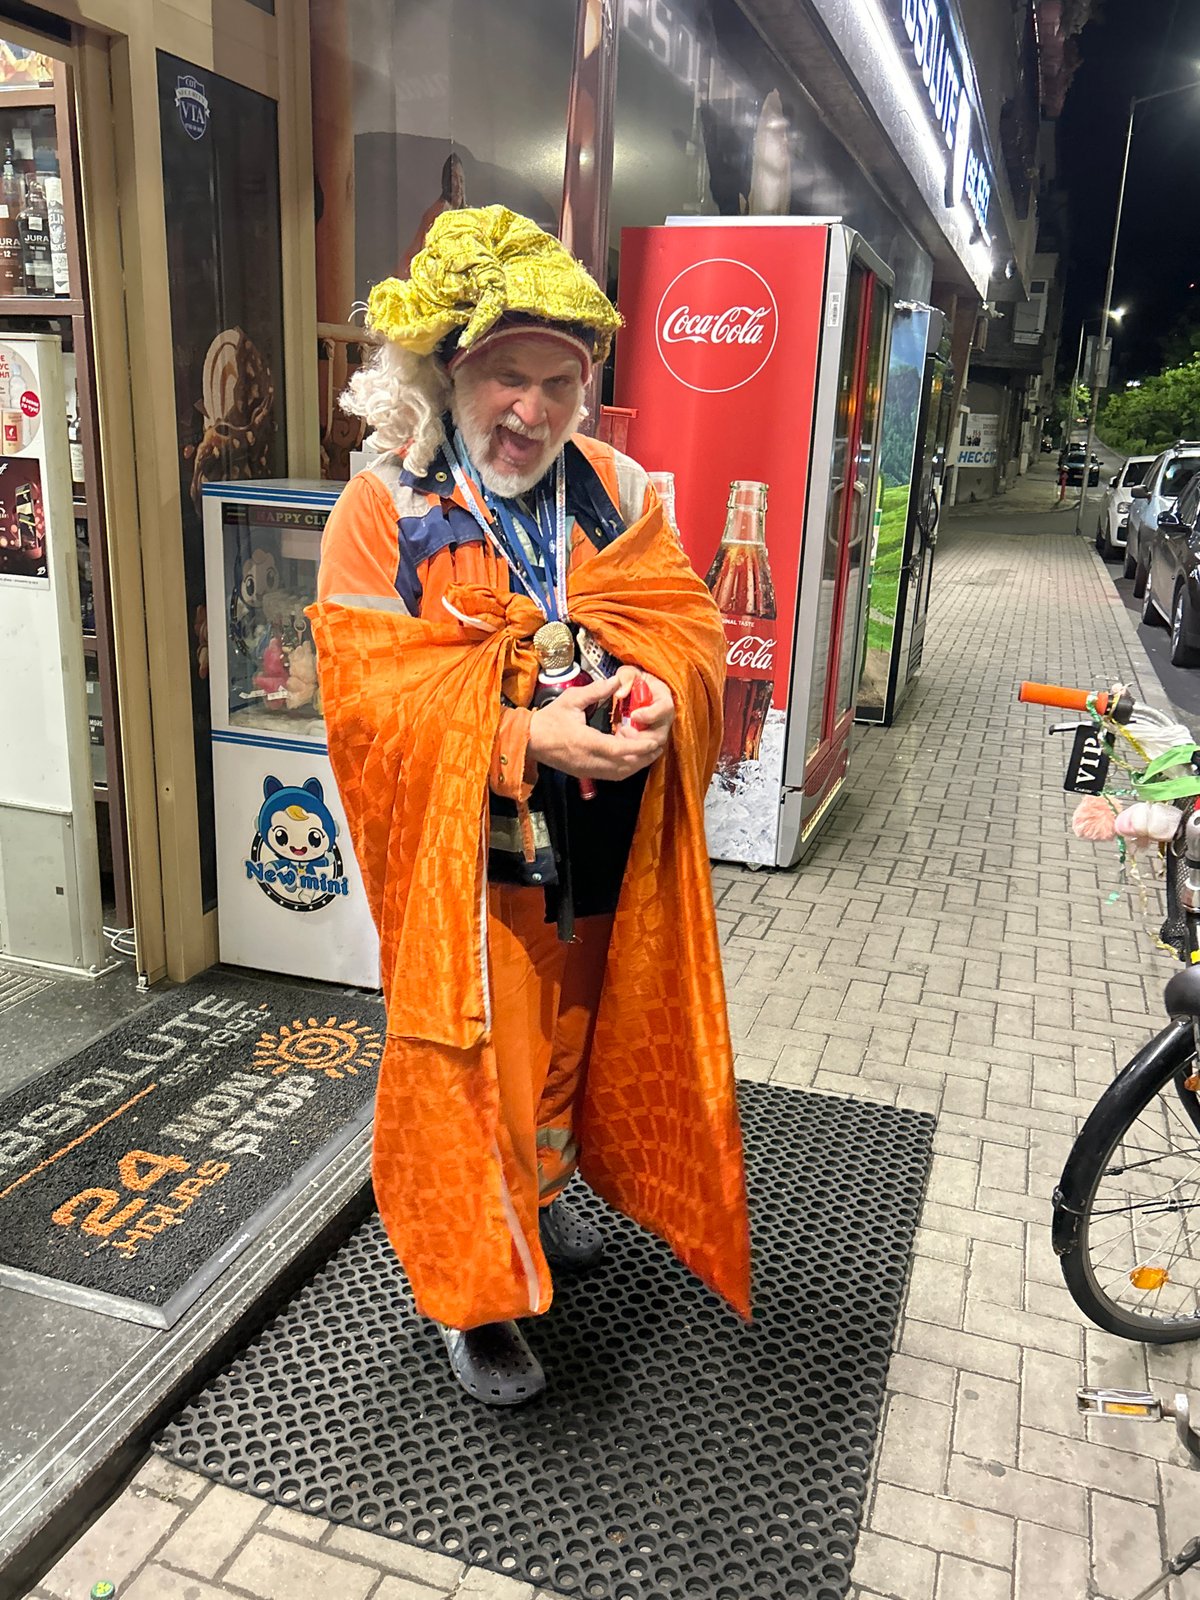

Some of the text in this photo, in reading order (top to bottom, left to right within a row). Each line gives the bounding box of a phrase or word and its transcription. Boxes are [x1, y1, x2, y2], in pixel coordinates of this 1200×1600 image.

[902, 0, 959, 150] SOLUTE
[181, 101, 205, 124] VTA
[3, 250, 11, 258] 12
[24, 234, 49, 243] JURA
[662, 305, 772, 344] Coca-Cola
[256, 511, 301, 524] HAPPY
[1076, 737, 1104, 783] VIP
[245, 860, 348, 896] New mini
[0, 994, 248, 1177] BSOLUTE
[159, 1071, 272, 1142] NON
[210, 1075, 320, 1151] STOP
[51, 1150, 191, 1237] 24
[112, 1160, 231, 1252] HOURS
